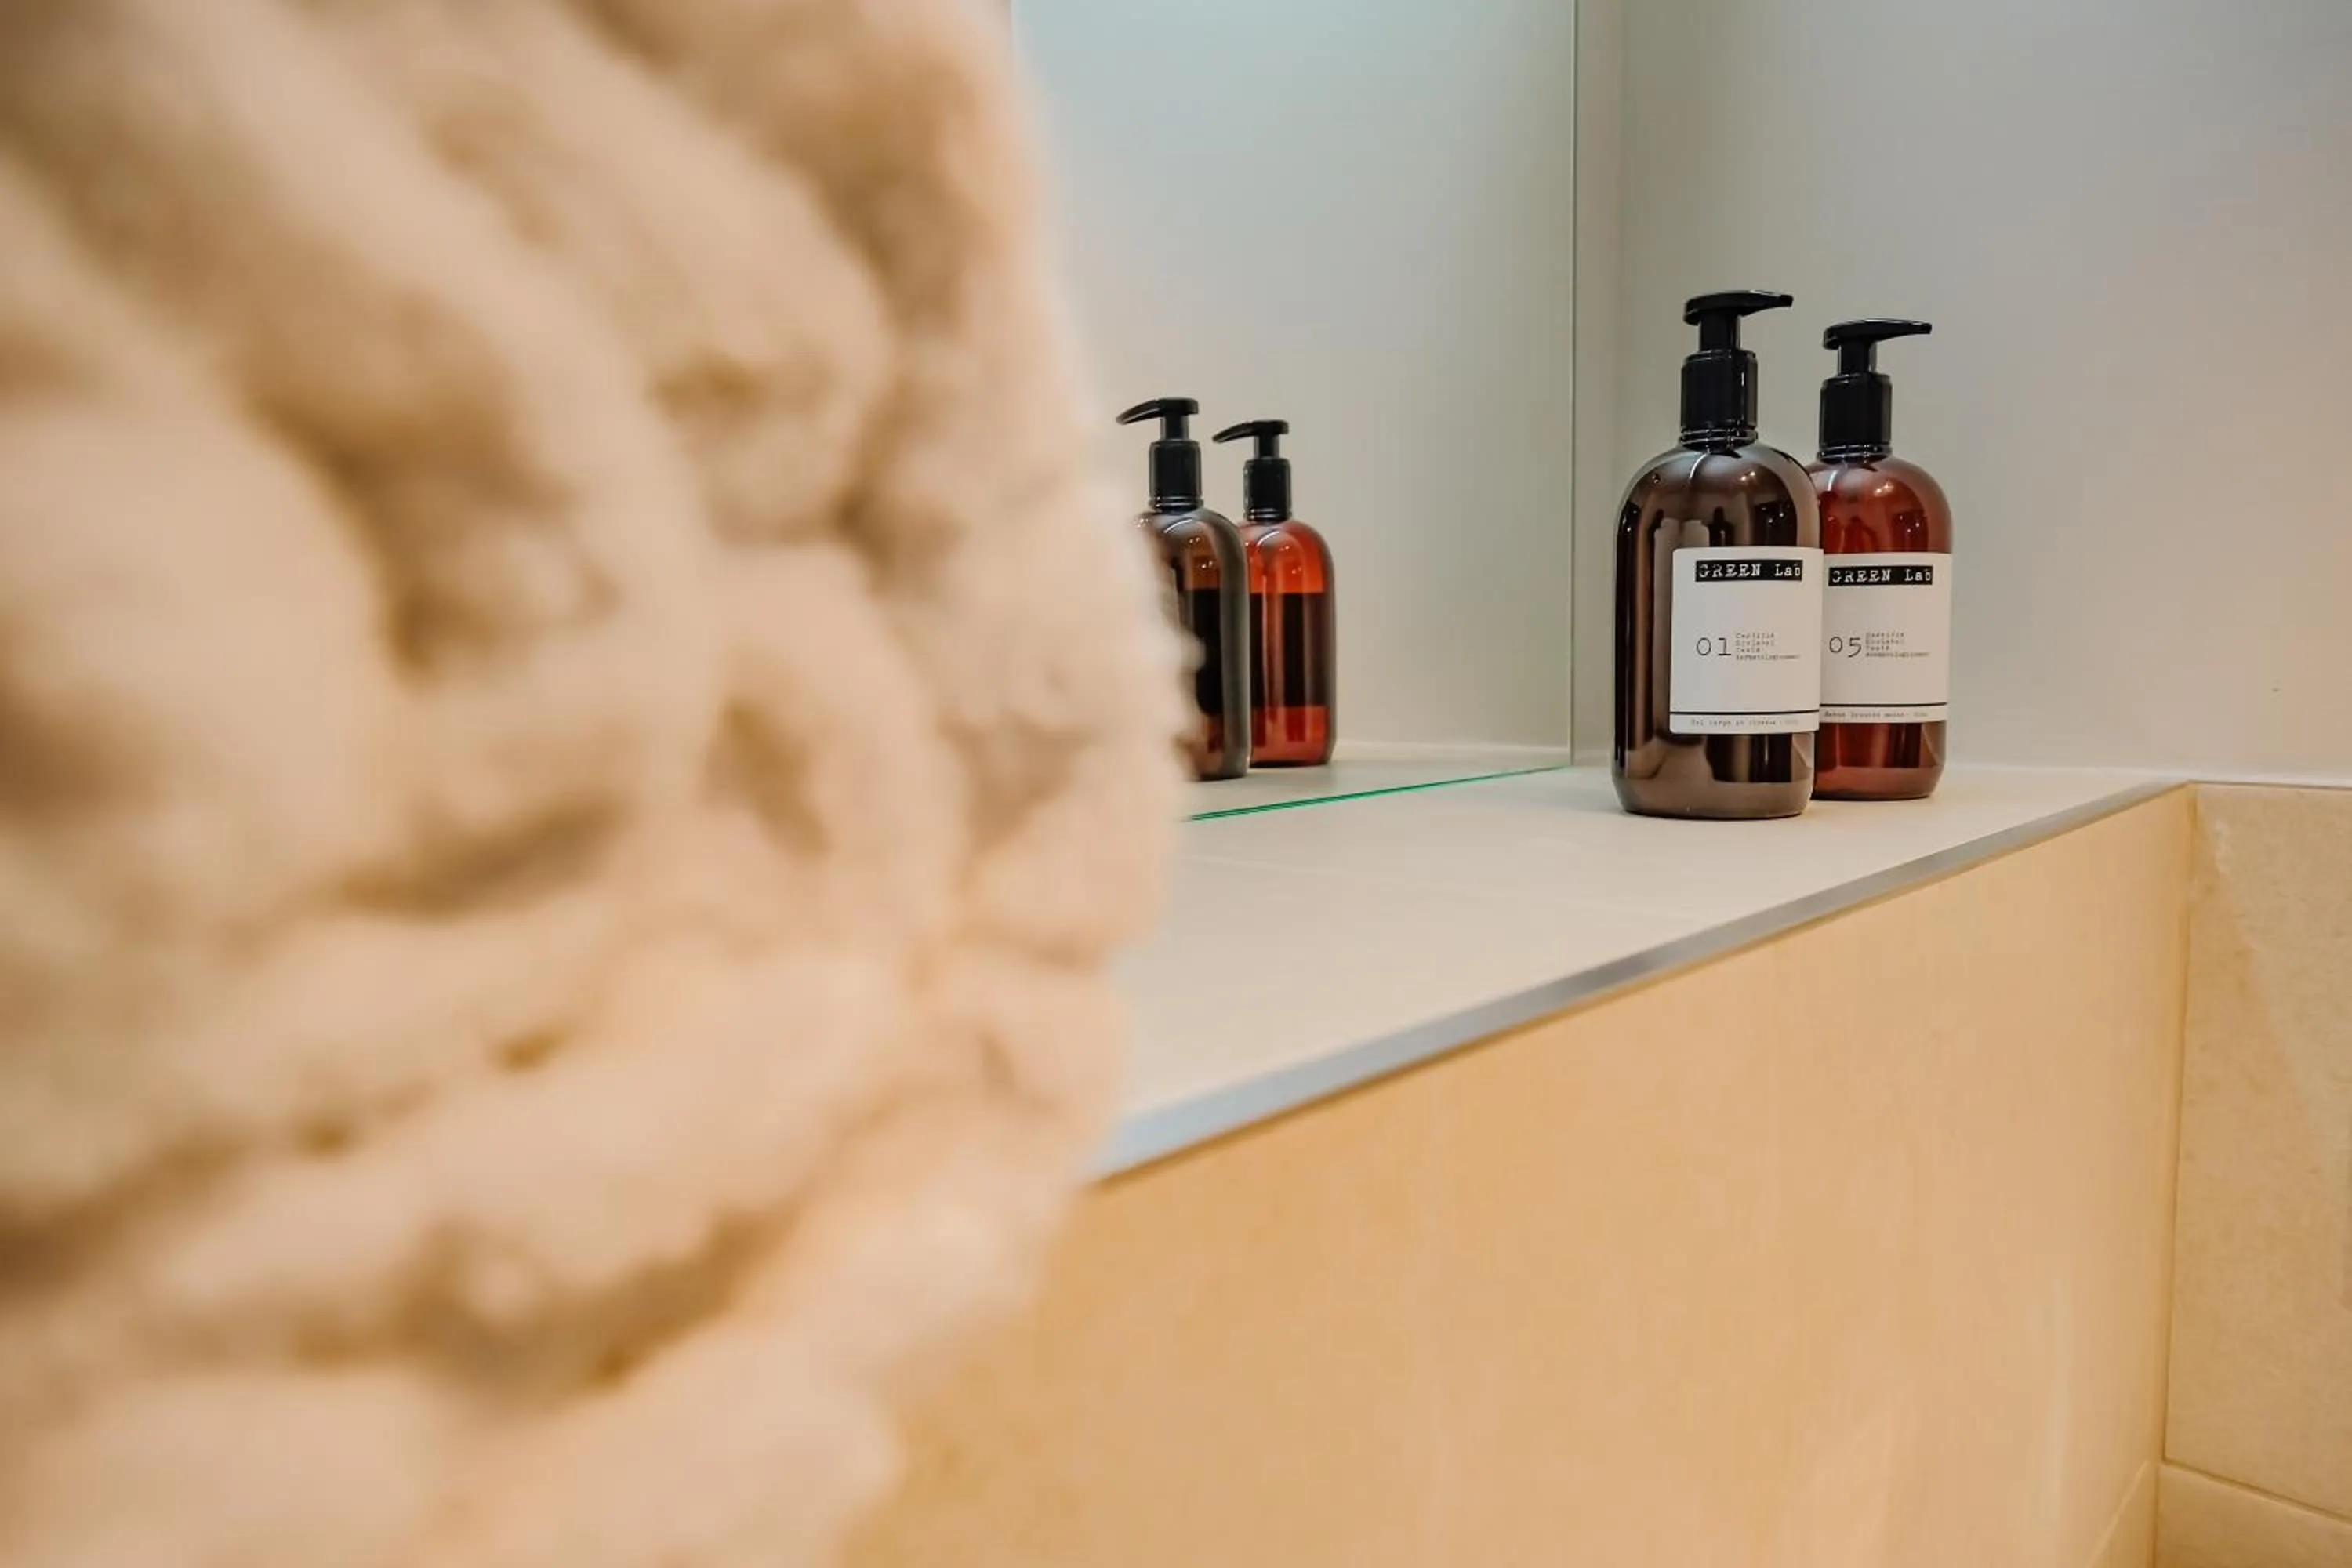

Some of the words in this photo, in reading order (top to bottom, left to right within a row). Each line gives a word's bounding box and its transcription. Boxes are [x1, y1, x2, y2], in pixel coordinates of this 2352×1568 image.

[1698, 563, 1762, 578] GREEN
[1774, 563, 1802, 577] Lab
[1831, 568, 1892, 583] GREEN
[1904, 568, 1932, 582] Lab
[1696, 637, 1732, 657] 01
[1828, 635, 1863, 658] 05
